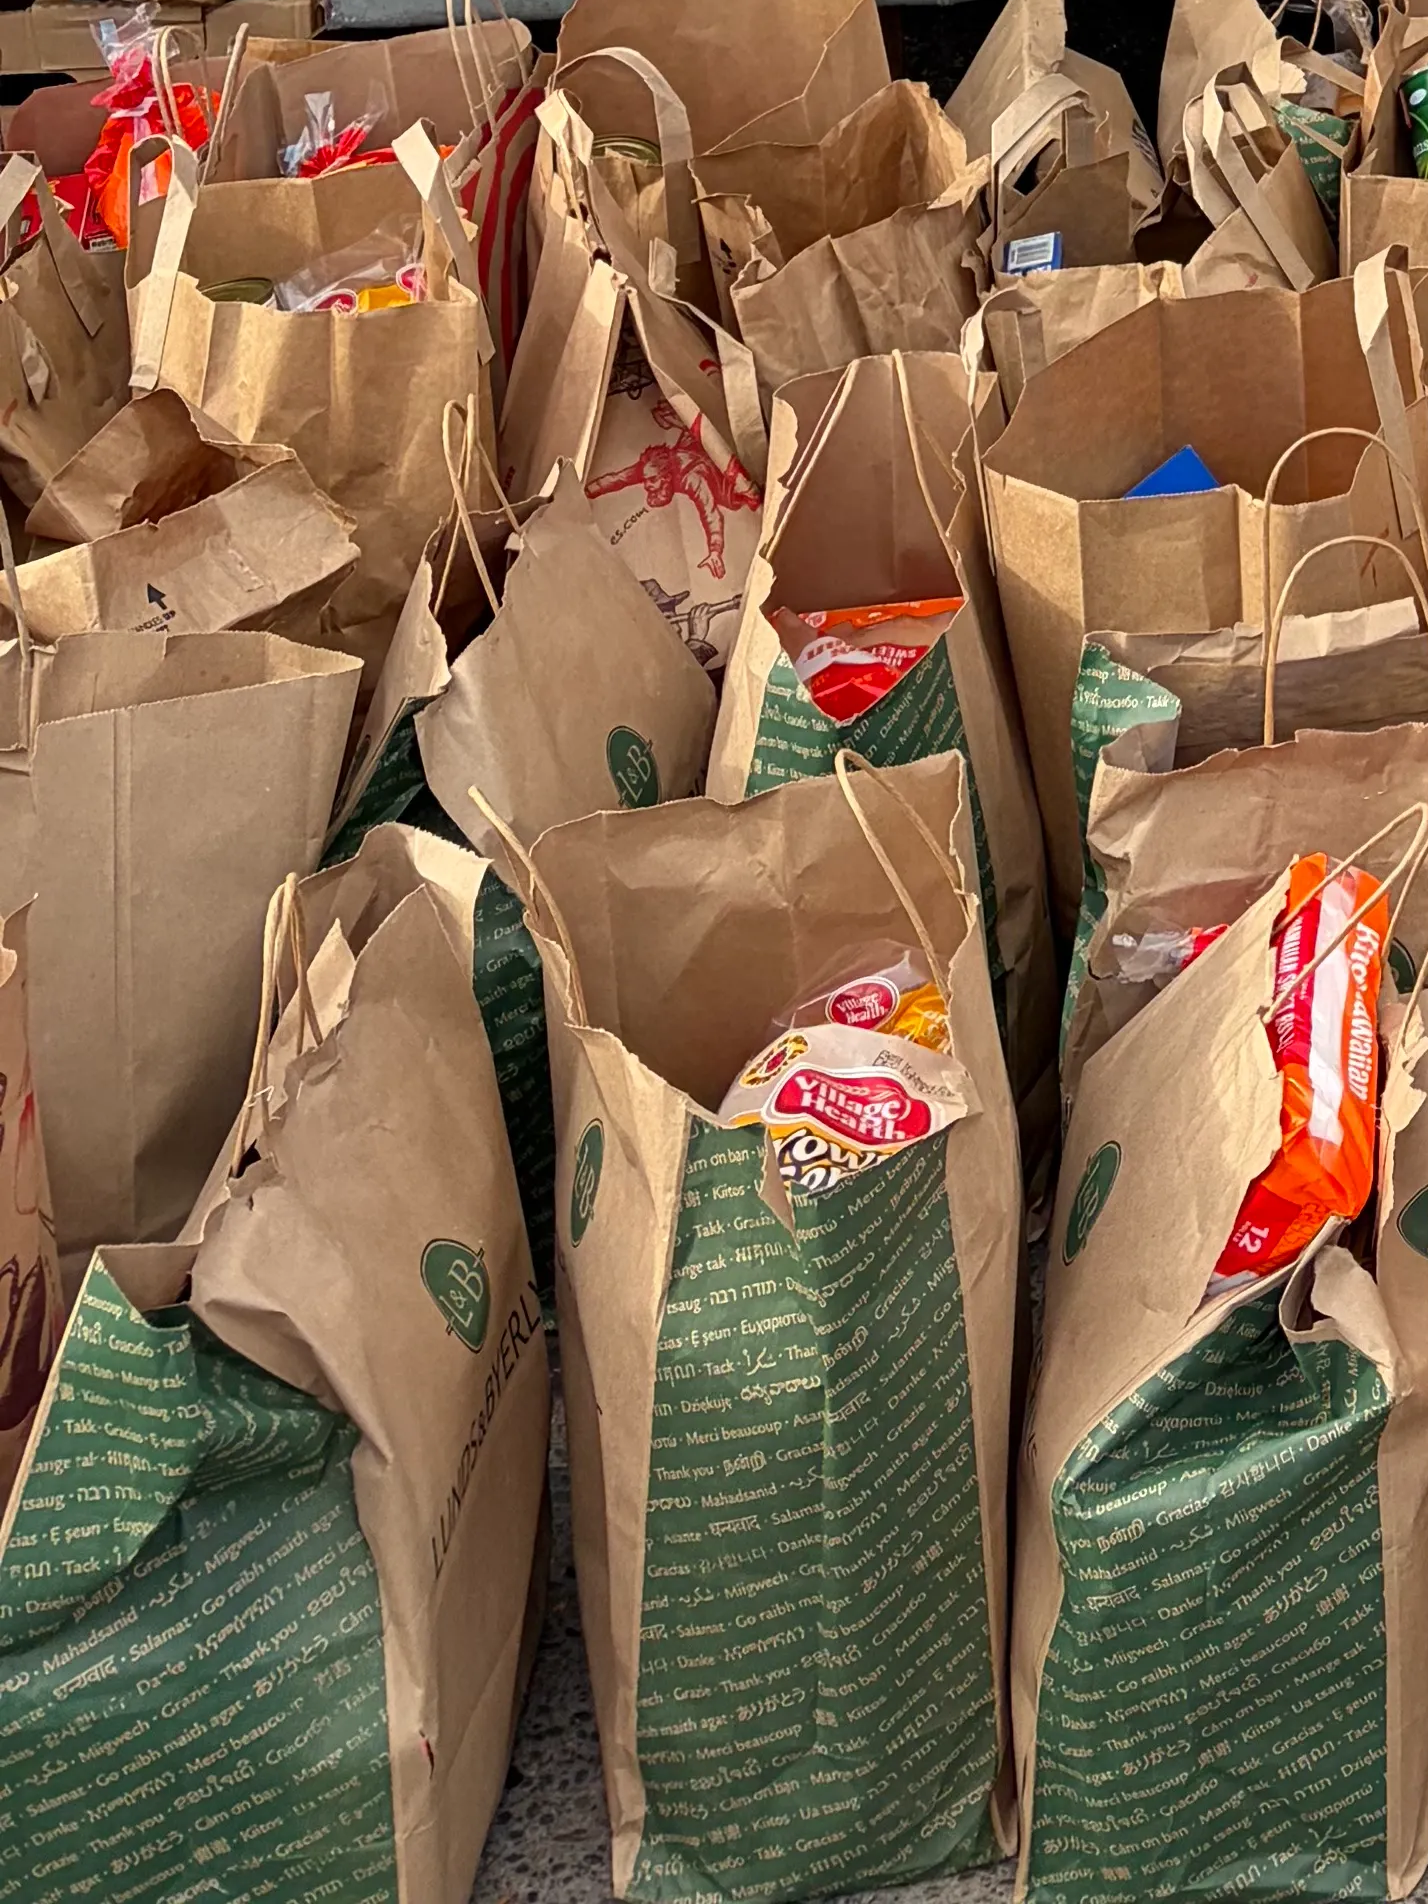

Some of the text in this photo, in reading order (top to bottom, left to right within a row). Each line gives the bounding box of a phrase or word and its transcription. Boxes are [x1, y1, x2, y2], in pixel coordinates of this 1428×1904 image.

[795, 1074, 901, 1119] Village
[712, 1184, 746, 1201] Kiitos
[693, 1221, 724, 1239] Takk
[438, 1258, 485, 1328] L&B
[706, 1359, 735, 1376] Tack
[685, 1420, 783, 1446] Merci beaucoup
[1305, 1418, 1353, 1452] Danke
[653, 1464, 714, 1482] Thank you
[700, 1482, 778, 1510] Mahadsanid
[1096, 1478, 1168, 1517] beaucoup
[1155, 1495, 1211, 1527] Gracias
[1078, 1547, 1159, 1582] Mahadsanid
[1152, 1560, 1211, 1593] Salamat
[724, 1570, 789, 1601] Miigwech
[735, 1601, 796, 1630] Go raibh
[42, 1605, 139, 1675] Mahadsanid
[129, 1615, 193, 1662] Salamat
[1199, 1619, 1308, 1691] Merci beaucoup
[1116, 1626, 1255, 1694] Go raibh maith agat
[720, 1666, 792, 1694] Thank you
[160, 1684, 211, 1719] Grazie
[79, 1720, 150, 1764] Miigwech
[696, 1722, 803, 1762] Merci beaucoup
[1241, 1714, 1282, 1743] Kiitos
